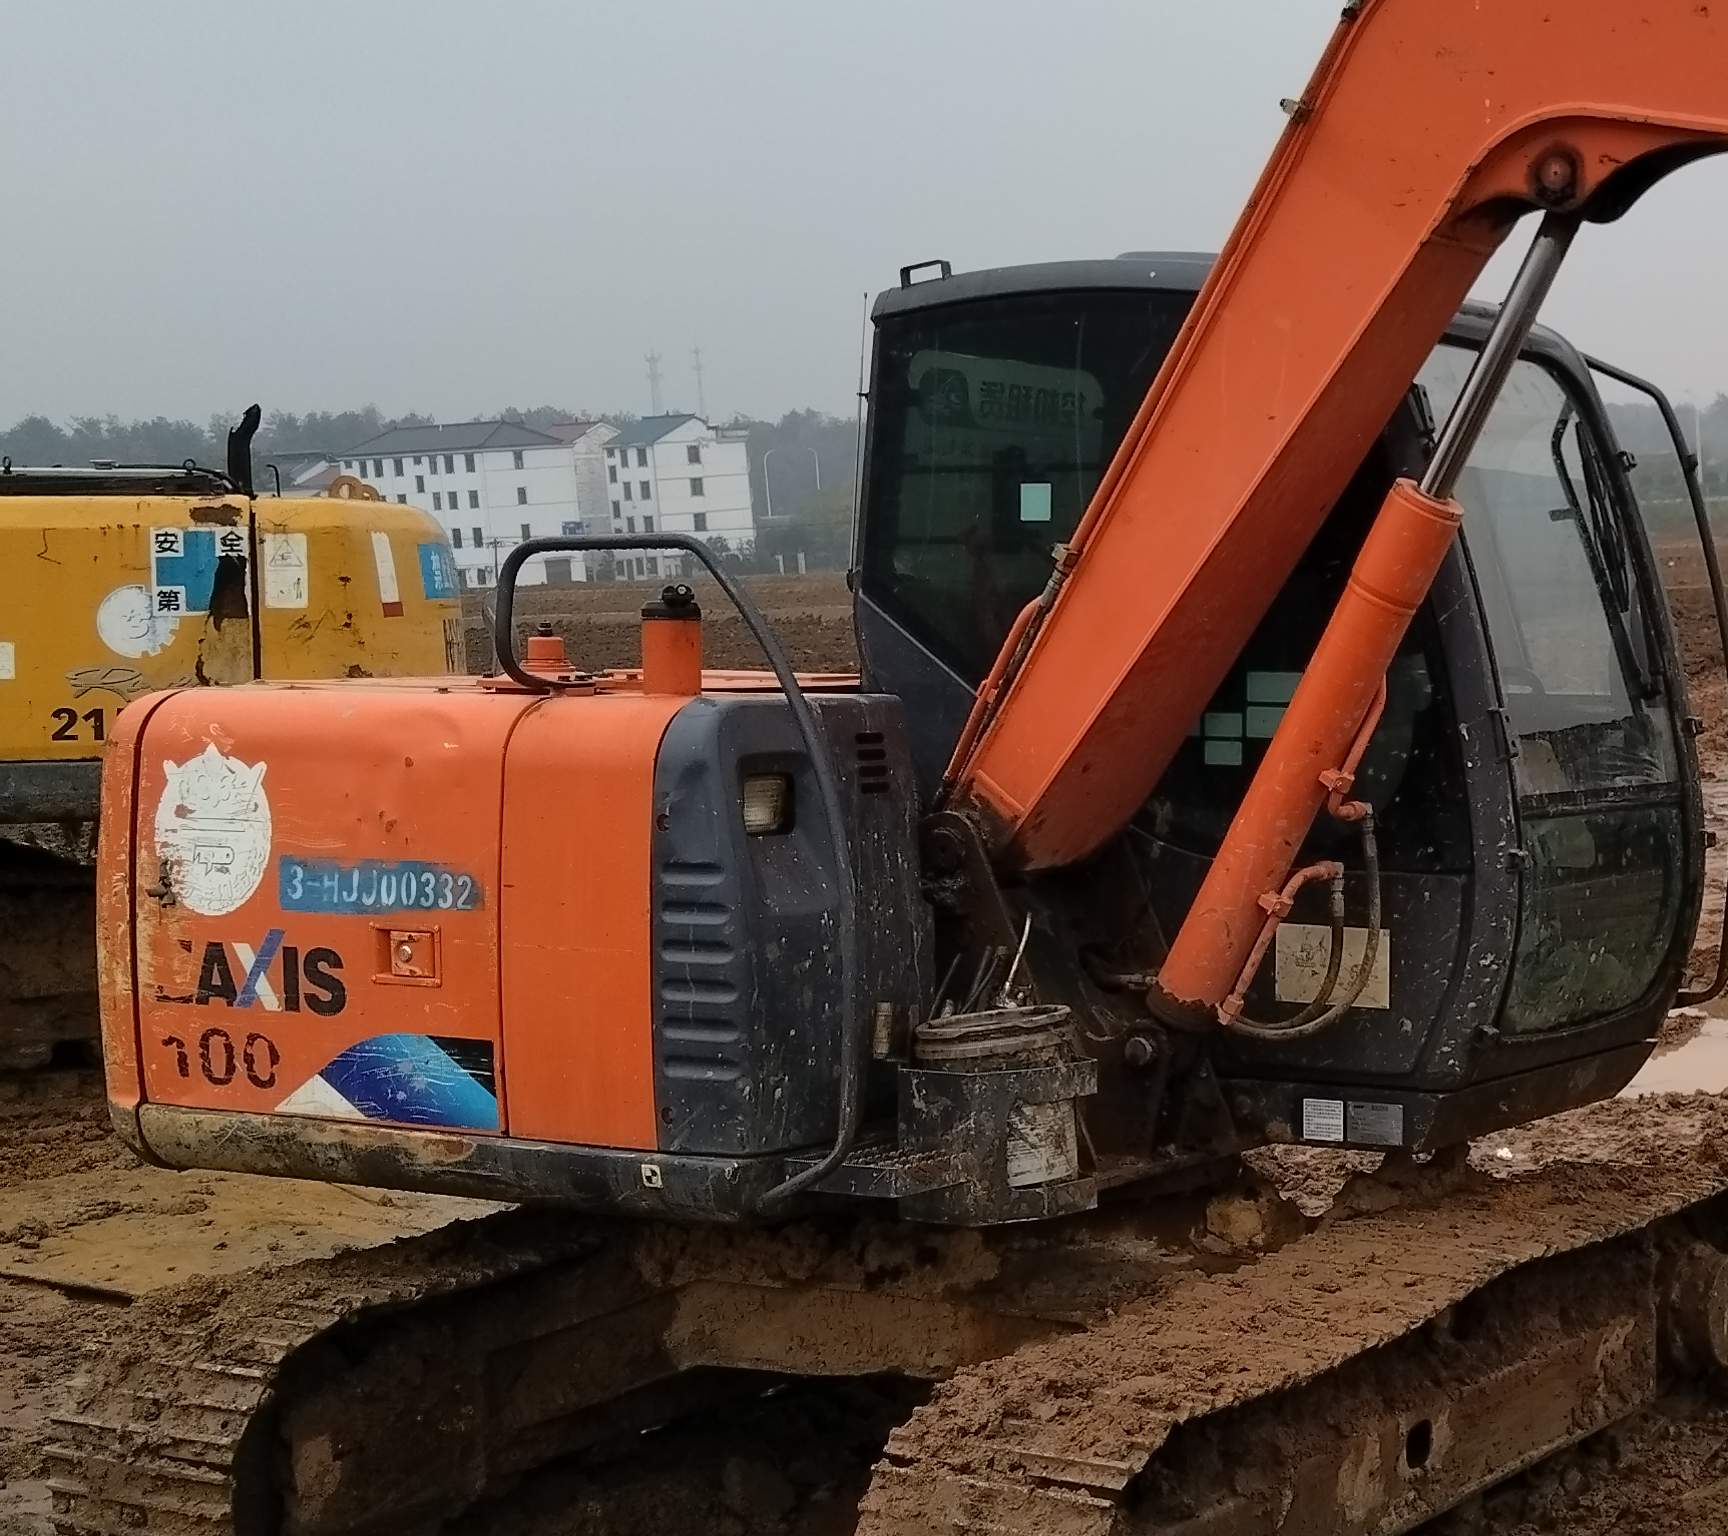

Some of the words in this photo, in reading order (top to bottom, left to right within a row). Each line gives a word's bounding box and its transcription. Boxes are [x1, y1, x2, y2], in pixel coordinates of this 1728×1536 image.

[157, 589, 181, 612] 第
[51, 707, 123, 741] 21
[162, 1027, 280, 1089] 100
